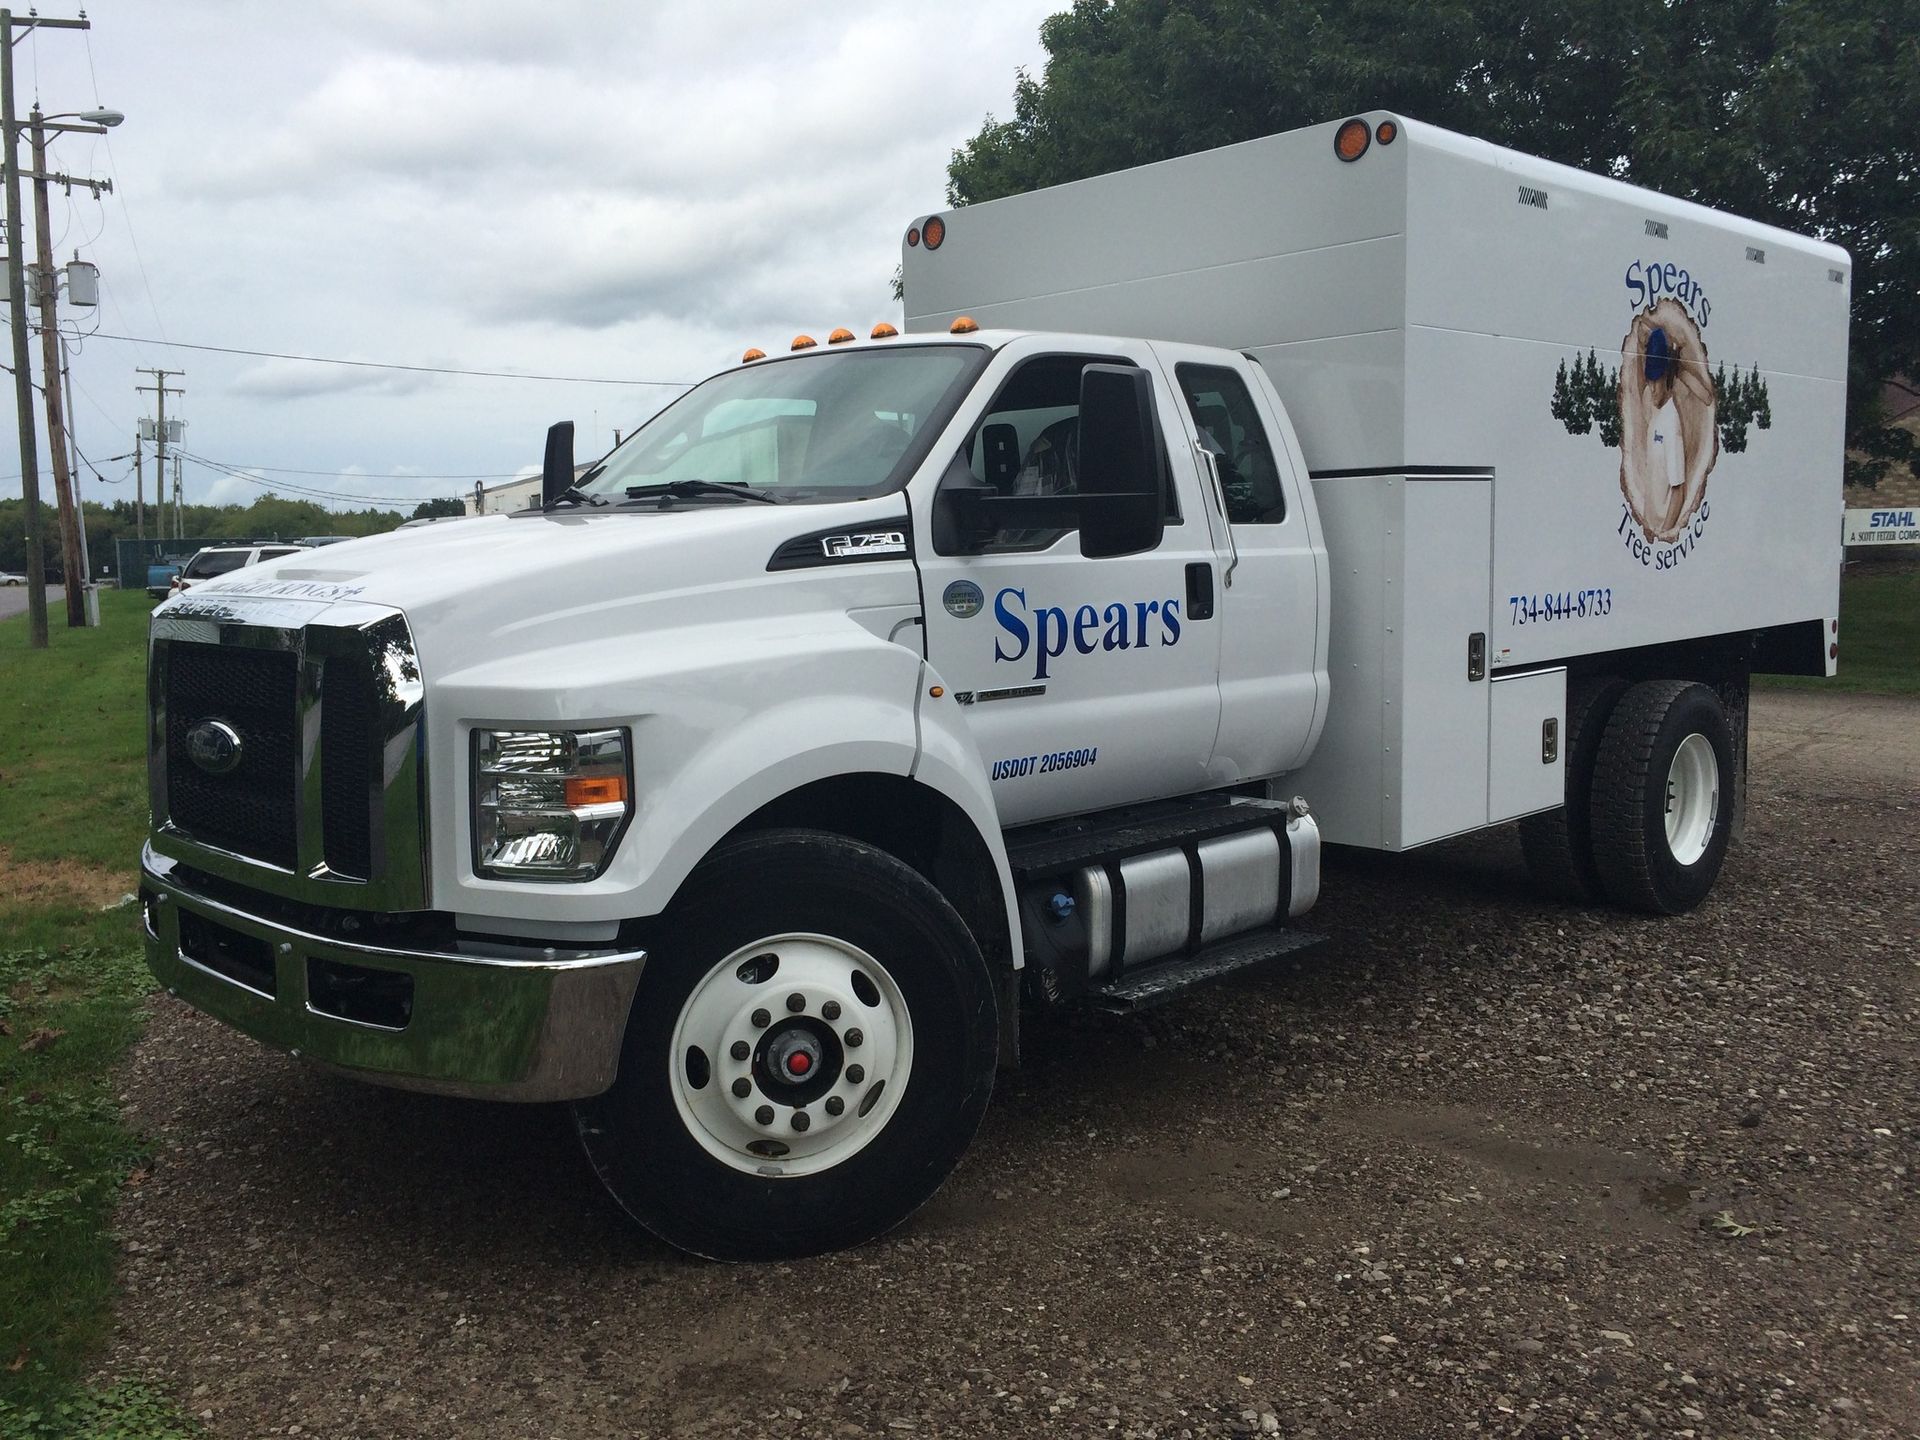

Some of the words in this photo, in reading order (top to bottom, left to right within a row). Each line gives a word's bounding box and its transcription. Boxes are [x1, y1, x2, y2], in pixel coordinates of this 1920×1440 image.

[1625, 259, 1711, 328] Spears
[1617, 503, 1651, 566] Tree
[1655, 501, 1710, 570] service
[1850, 532, 1856, 542] A
[1858, 531, 1876, 542] SCOTT
[1898, 529, 1920, 540] COMP
[1870, 511, 1916, 527] STAHL
[1510, 588, 1612, 626] 734-844-8733
[994, 587, 1181, 680] Spears
[992, 756, 1038, 781] USDOT
[1039, 747, 1098, 774] 2056904
